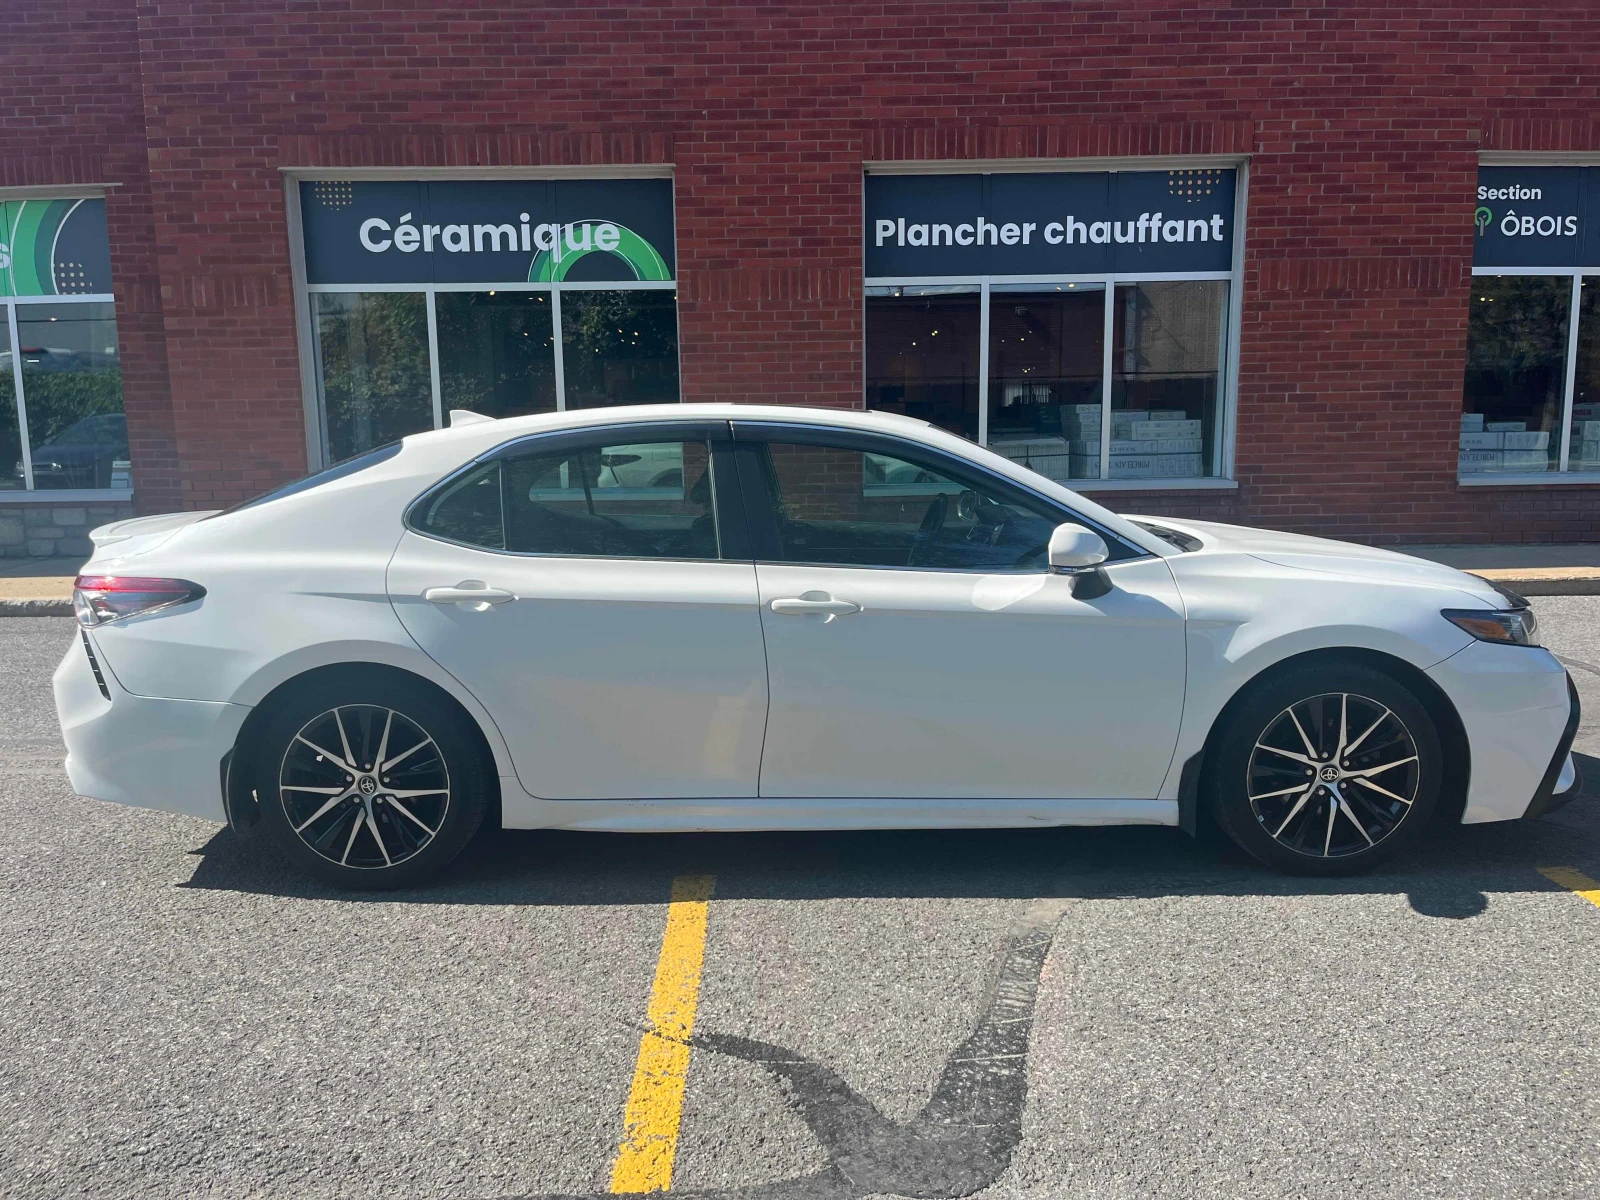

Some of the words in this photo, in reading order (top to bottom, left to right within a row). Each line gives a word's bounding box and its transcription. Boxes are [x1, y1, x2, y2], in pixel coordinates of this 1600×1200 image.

[1477, 184, 1542, 200] Section
[875, 216, 1037, 247] Plancher
[1043, 212, 1224, 245] chauffant
[1500, 209, 1578, 237] ÔBOIS
[359, 212, 621, 264] Céramique
[1114, 460, 1150, 469] PORCELAIN
